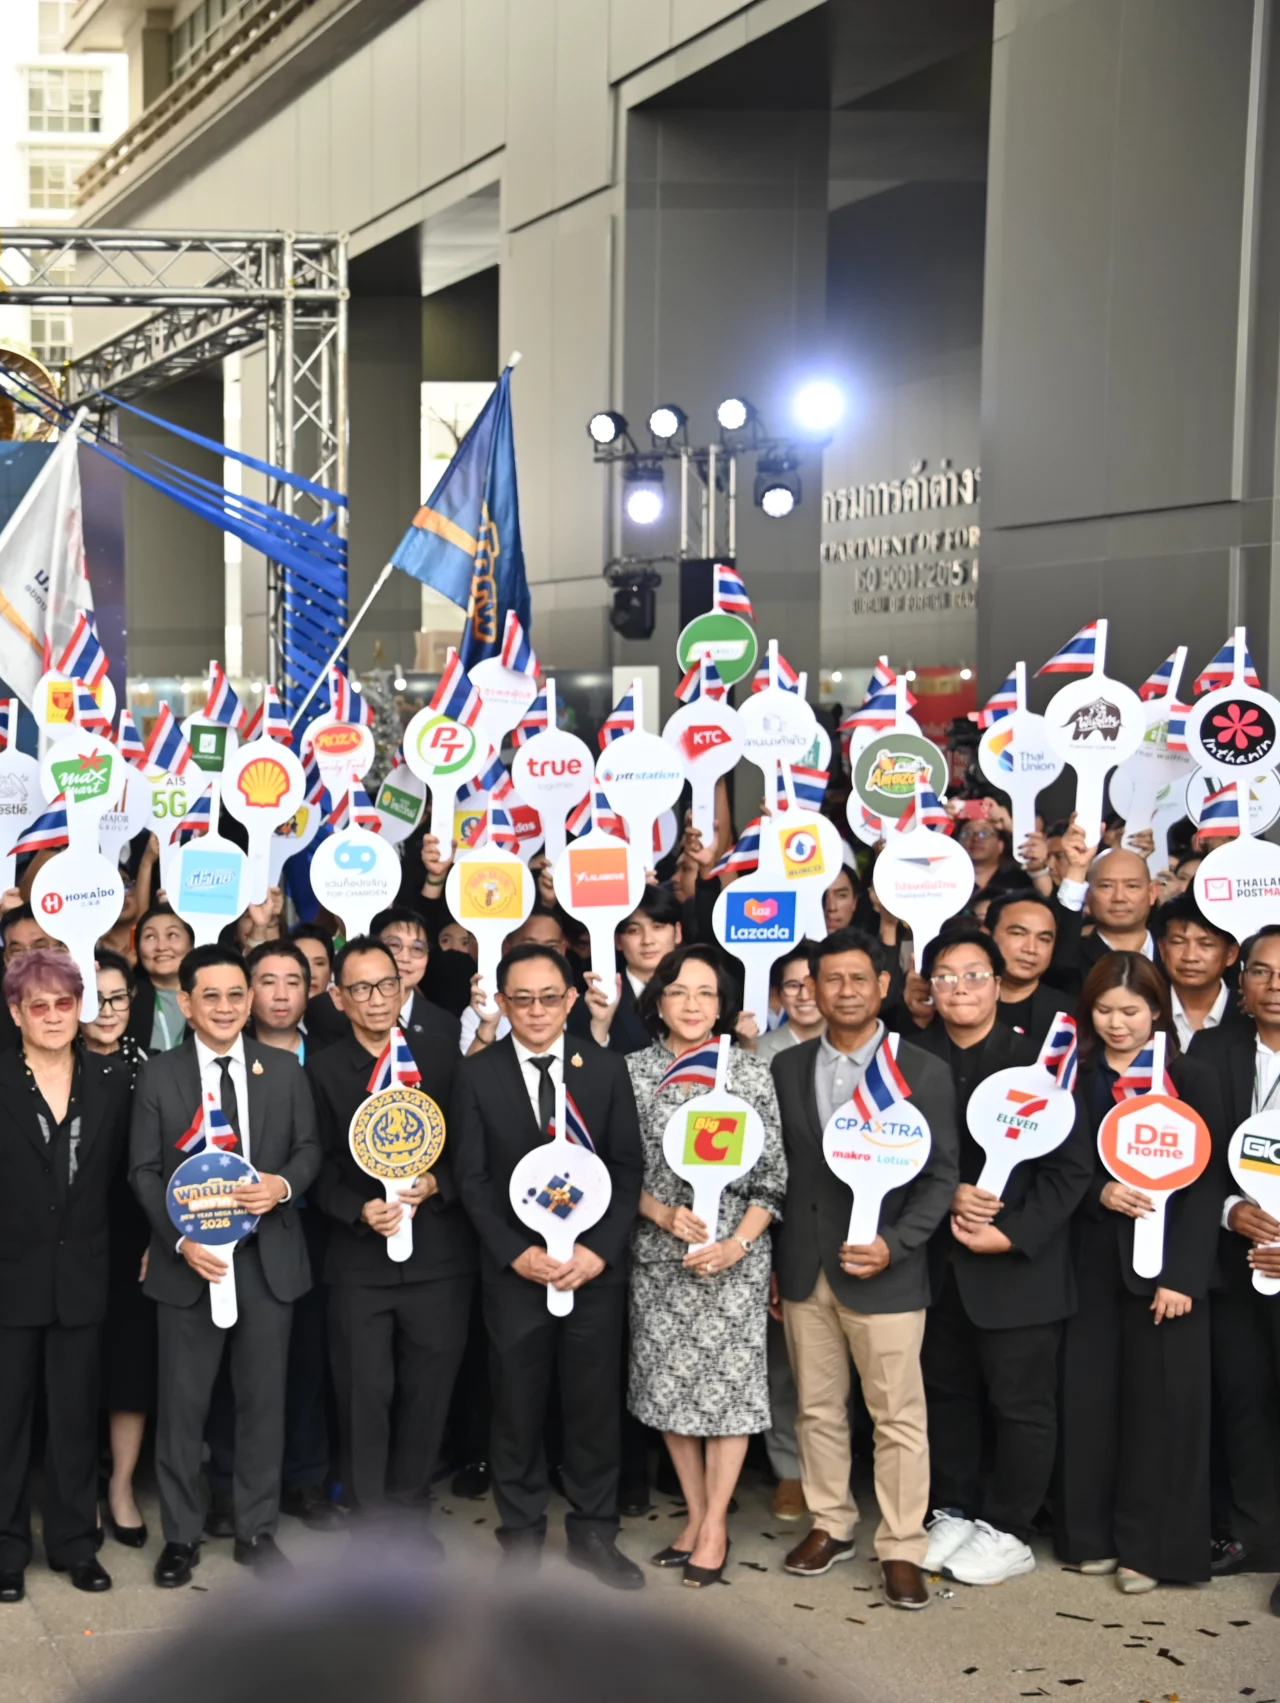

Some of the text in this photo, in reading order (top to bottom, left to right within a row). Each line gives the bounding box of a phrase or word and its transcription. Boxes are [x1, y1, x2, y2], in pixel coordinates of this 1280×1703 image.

[318, 731, 360, 748] ROZA
[430, 727, 464, 762] PT
[693, 730, 722, 745] KTC
[1019, 751, 1044, 761] Thai
[527, 757, 582, 777] true
[1021, 762, 1056, 772] Union
[166, 776, 187, 786] AIS
[615, 768, 681, 782] ptt station
[152, 789, 187, 819] 5G
[1236, 877, 1280, 888] THAILA
[751, 904, 771, 918] Laz
[731, 924, 790, 940] Lazada
[835, 1117, 923, 1138] CP AXTRA
[693, 1116, 738, 1162] Big C
[832, 1150, 871, 1162] makro
[1127, 1143, 1184, 1160] home
[200, 1217, 231, 1231] 2026
